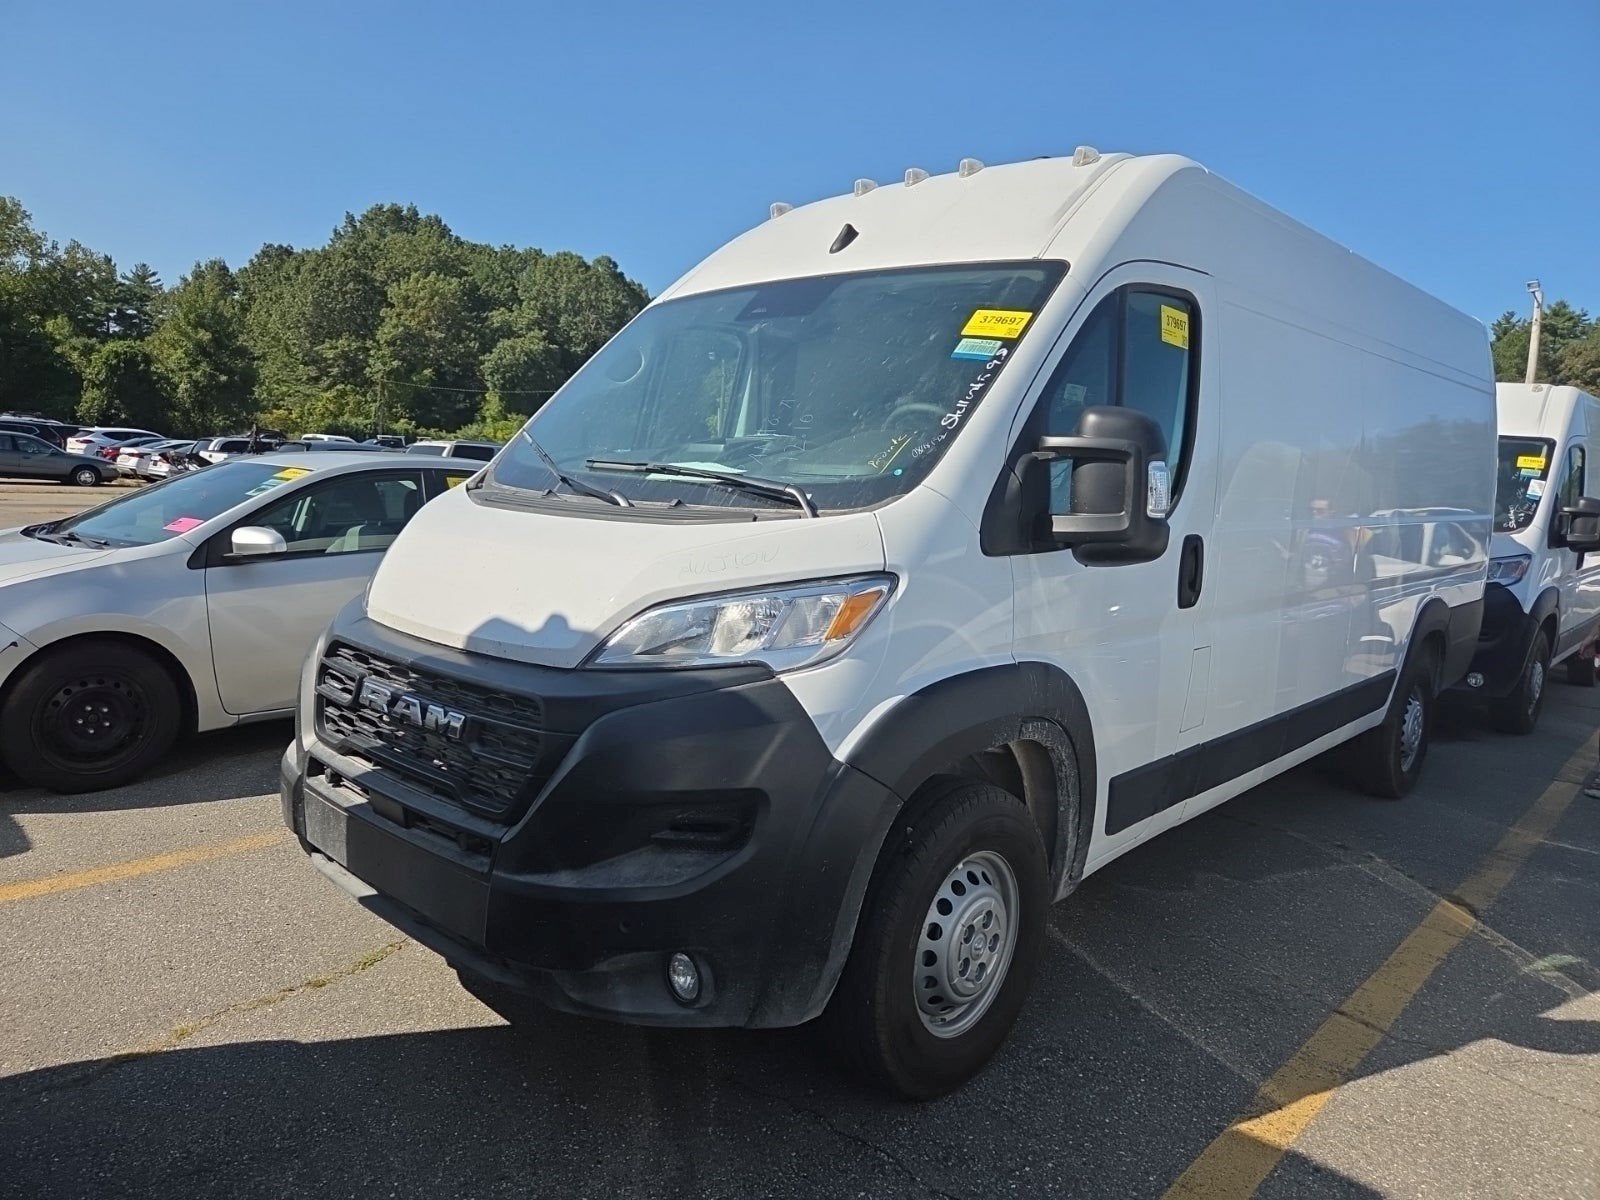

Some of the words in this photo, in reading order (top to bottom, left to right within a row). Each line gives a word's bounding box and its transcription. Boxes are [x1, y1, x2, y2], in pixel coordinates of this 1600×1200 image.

[979, 315, 1024, 326] 379697
[1166, 315, 1187, 332] 379697
[359, 680, 466, 739] RAM
